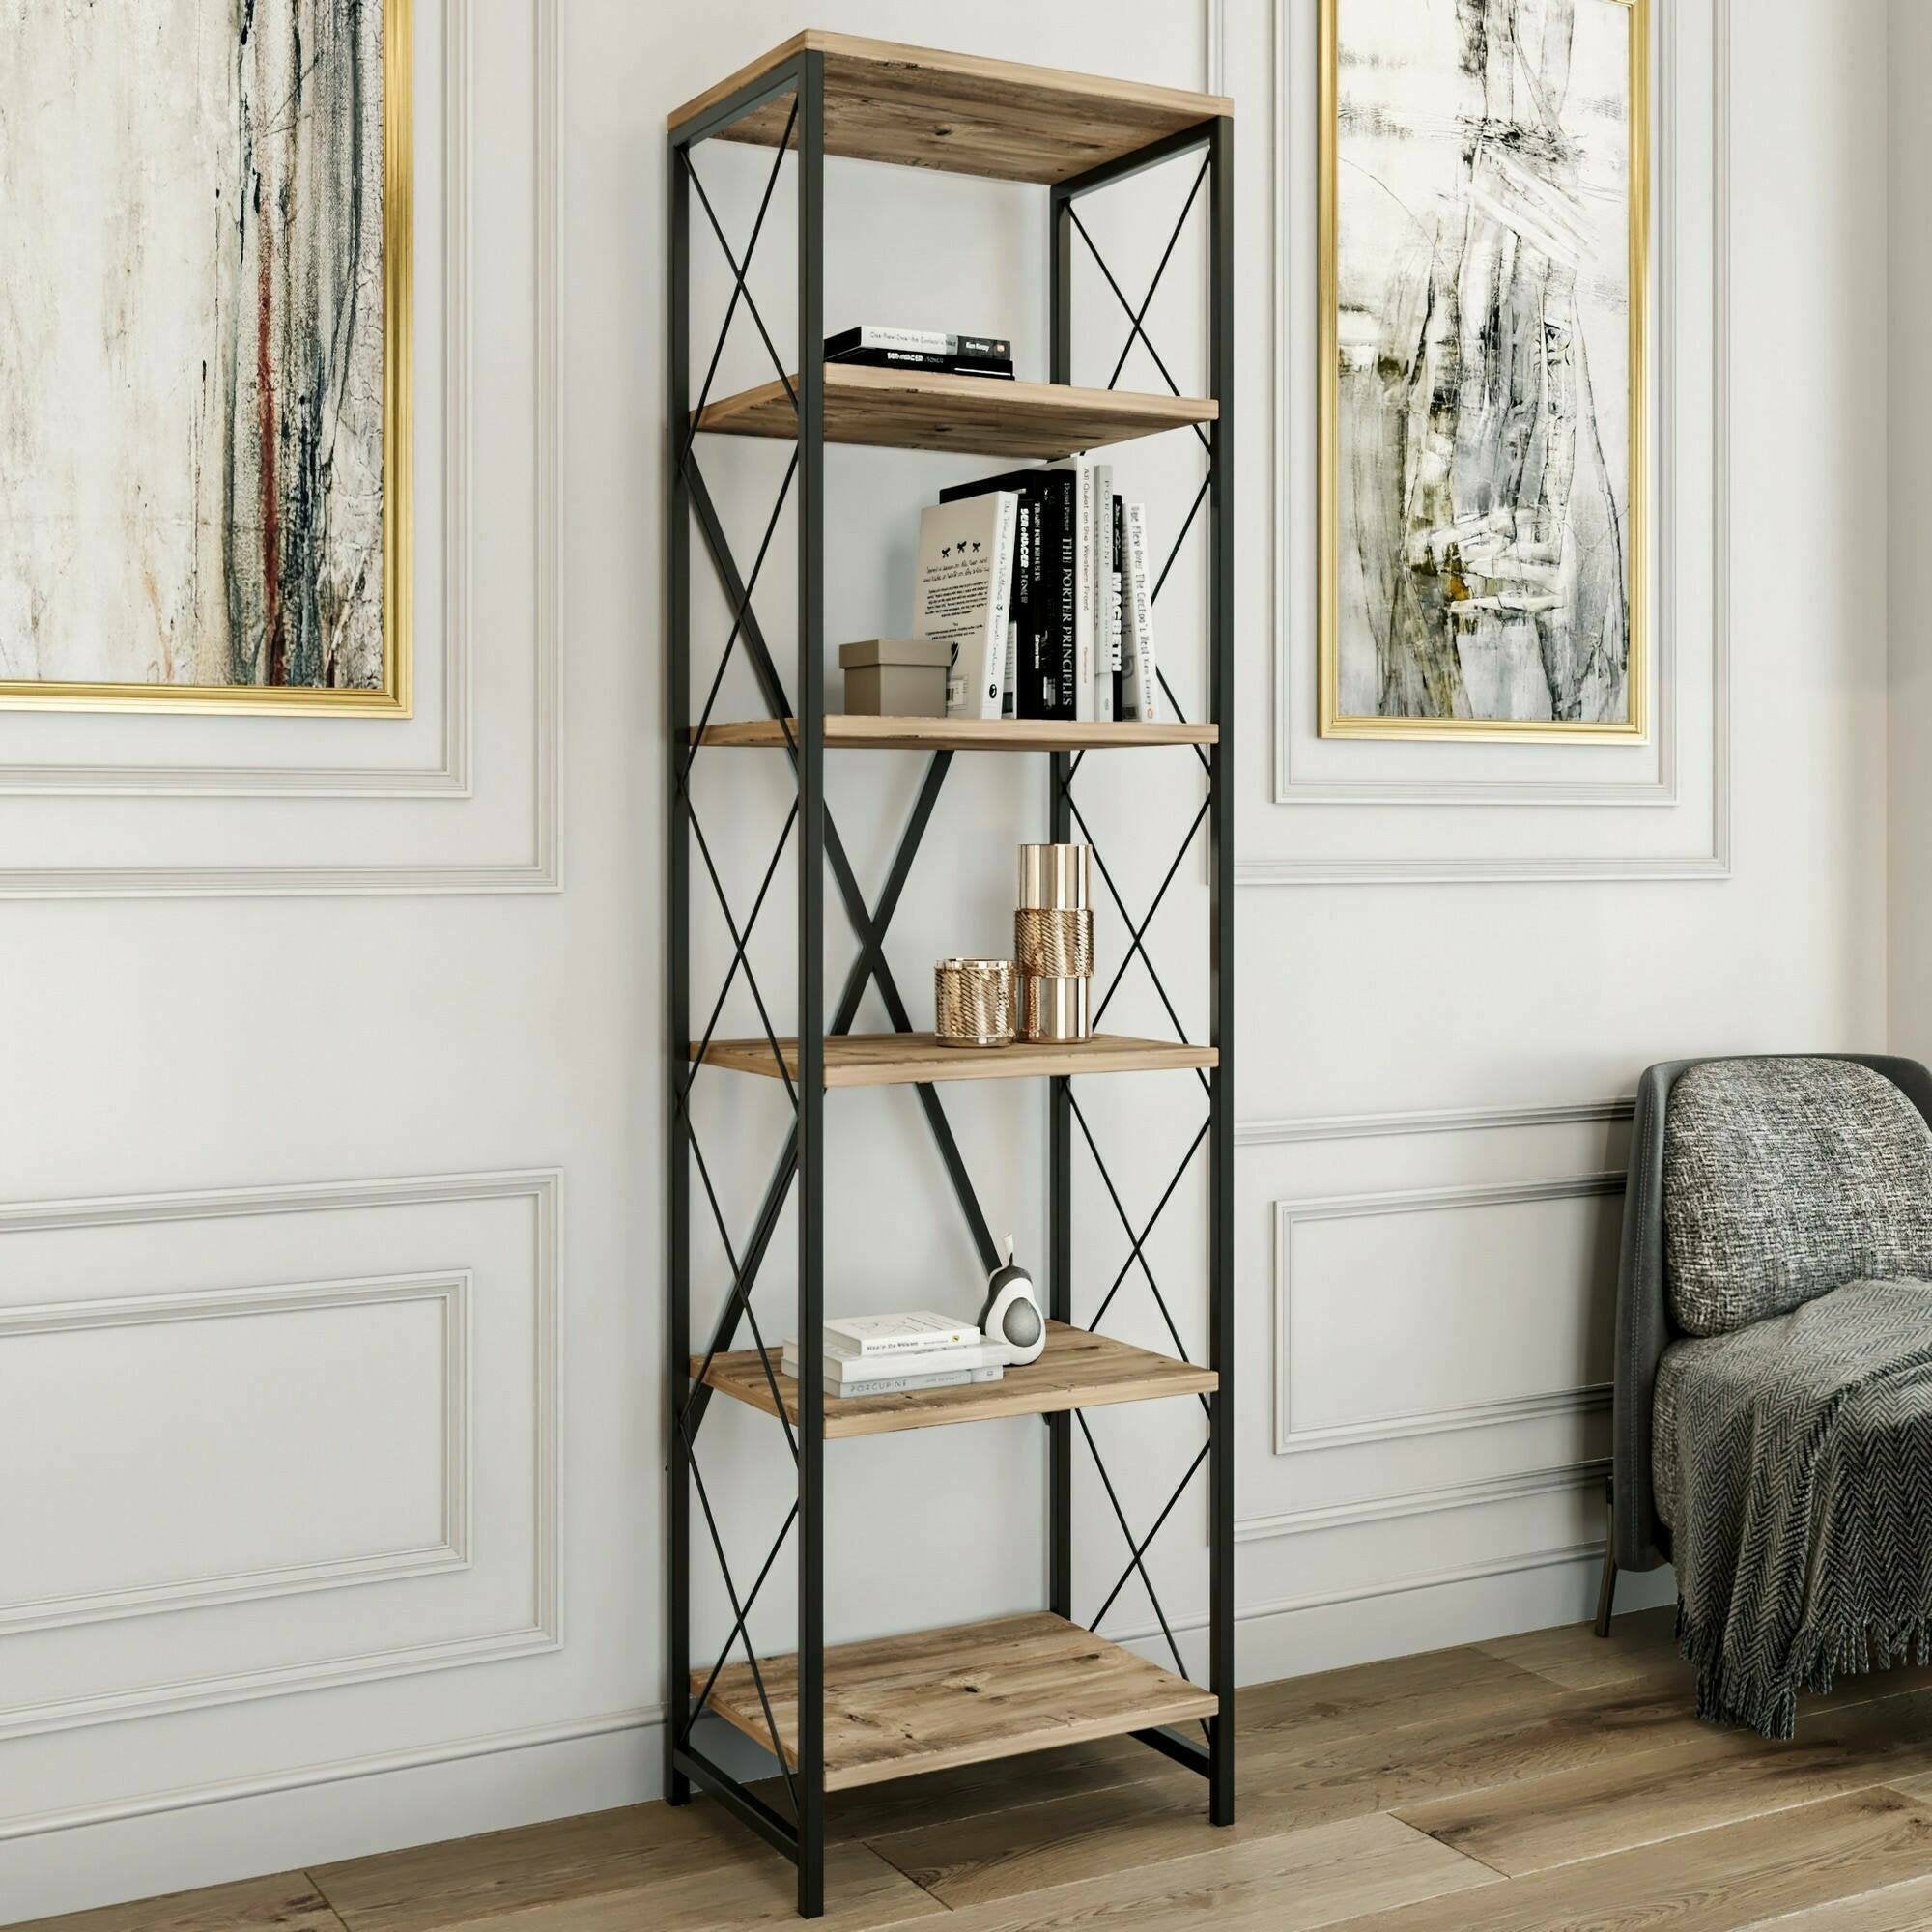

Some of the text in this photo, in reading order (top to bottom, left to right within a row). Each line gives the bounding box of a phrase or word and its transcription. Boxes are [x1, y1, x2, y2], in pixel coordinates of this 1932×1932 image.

[1062, 537, 1072, 563] THE
[1062, 568, 1072, 621] PORTER
[1062, 626, 1073, 706] PRINCIPLES
